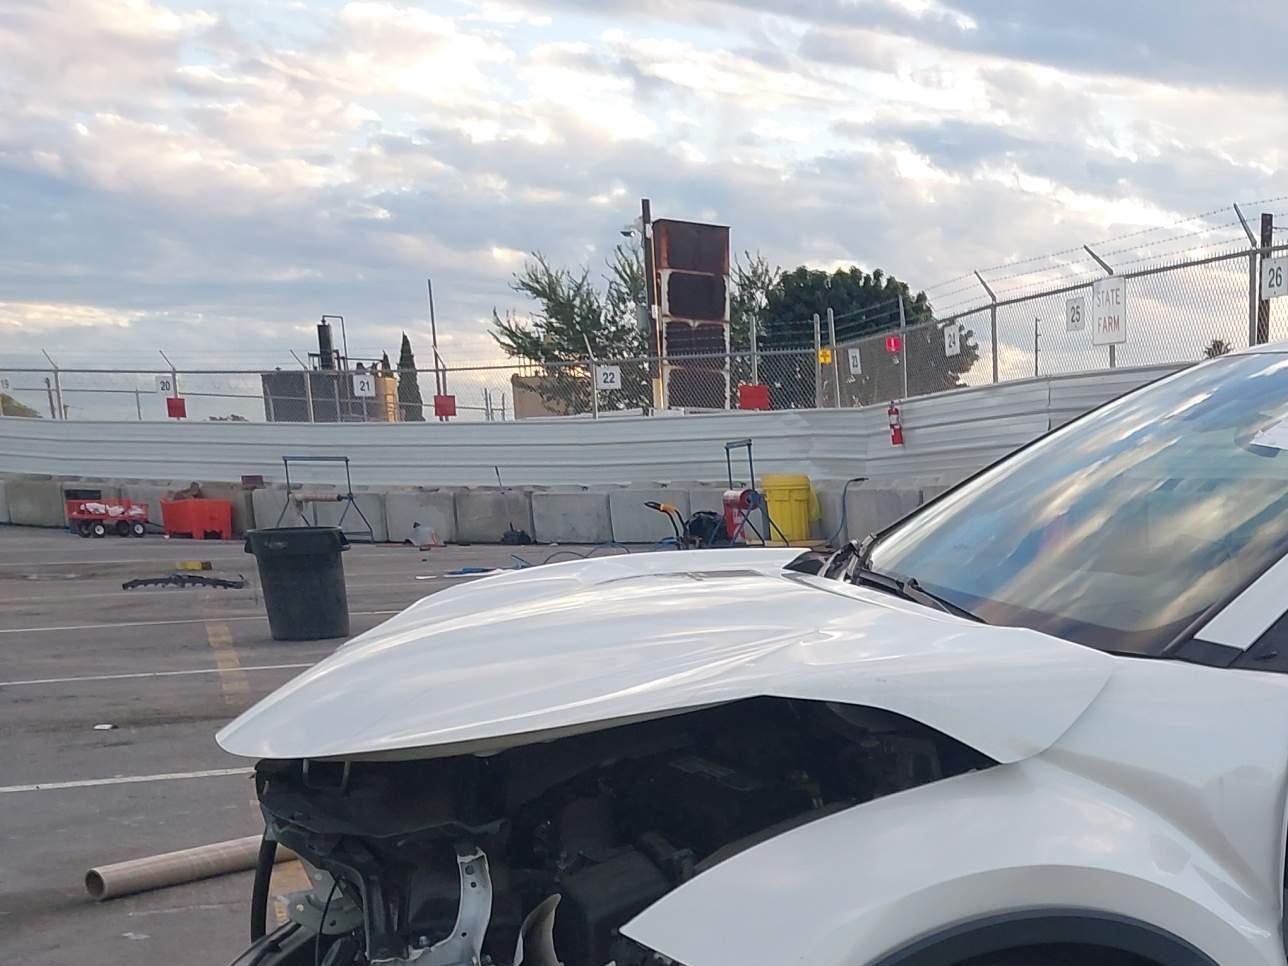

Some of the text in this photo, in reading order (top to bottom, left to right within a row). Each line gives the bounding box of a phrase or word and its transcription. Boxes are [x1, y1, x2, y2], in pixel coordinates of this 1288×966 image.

[1268, 266, 1282, 288] 26
[1096, 288, 1120, 307] STATE
[1070, 306, 1080, 324] 25
[1098, 315, 1120, 333] FARM
[160, 380, 171, 391] 20
[359, 380, 370, 392] 21
[602, 372, 615, 384] 22
